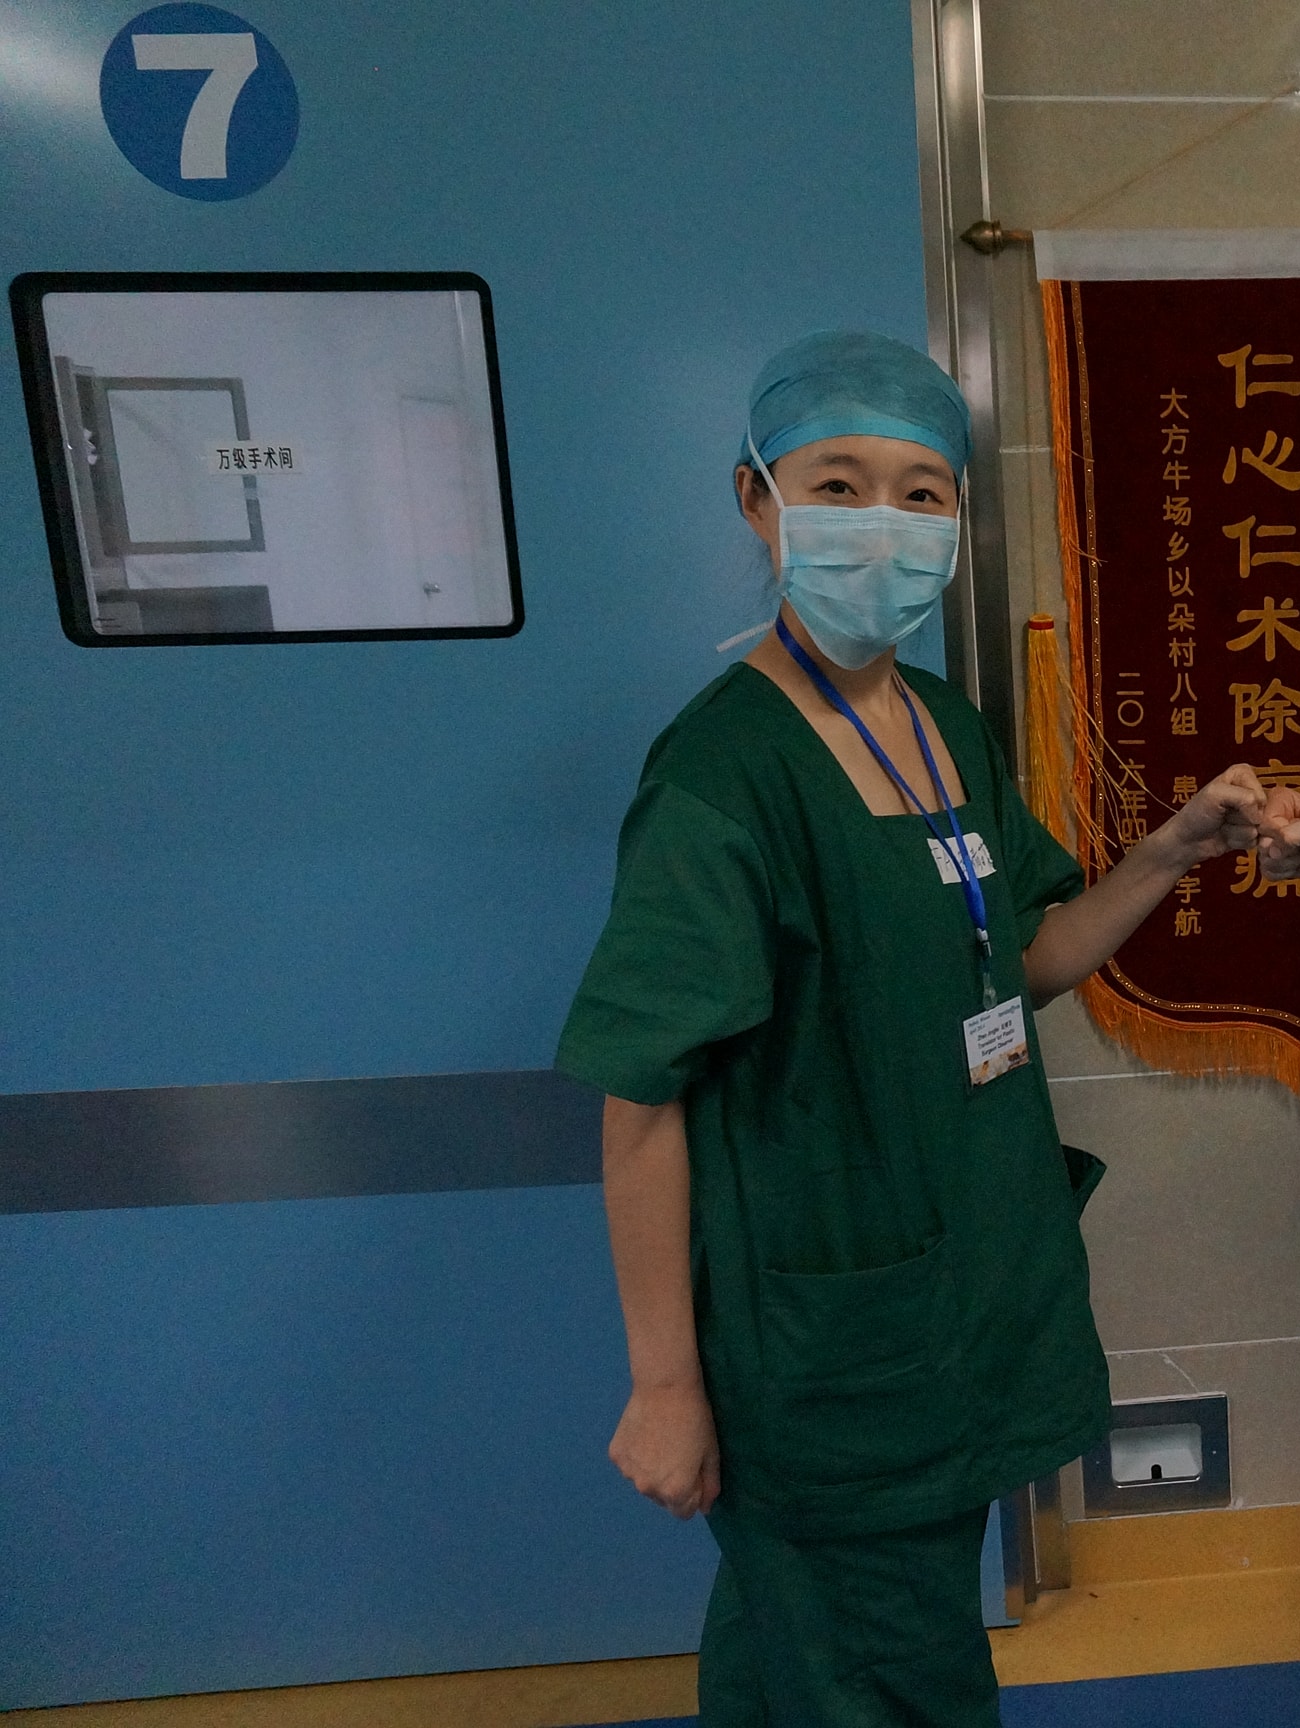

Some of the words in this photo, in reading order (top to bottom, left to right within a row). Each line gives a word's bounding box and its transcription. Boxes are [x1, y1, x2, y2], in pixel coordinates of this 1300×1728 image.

[131, 33, 258, 180] 7
[216, 447, 293, 470] 万级手术间
[1160, 388, 1199, 736] 大方牛场乡以朵村八组
[1117, 672, 1149, 853] 二〇一六年四
